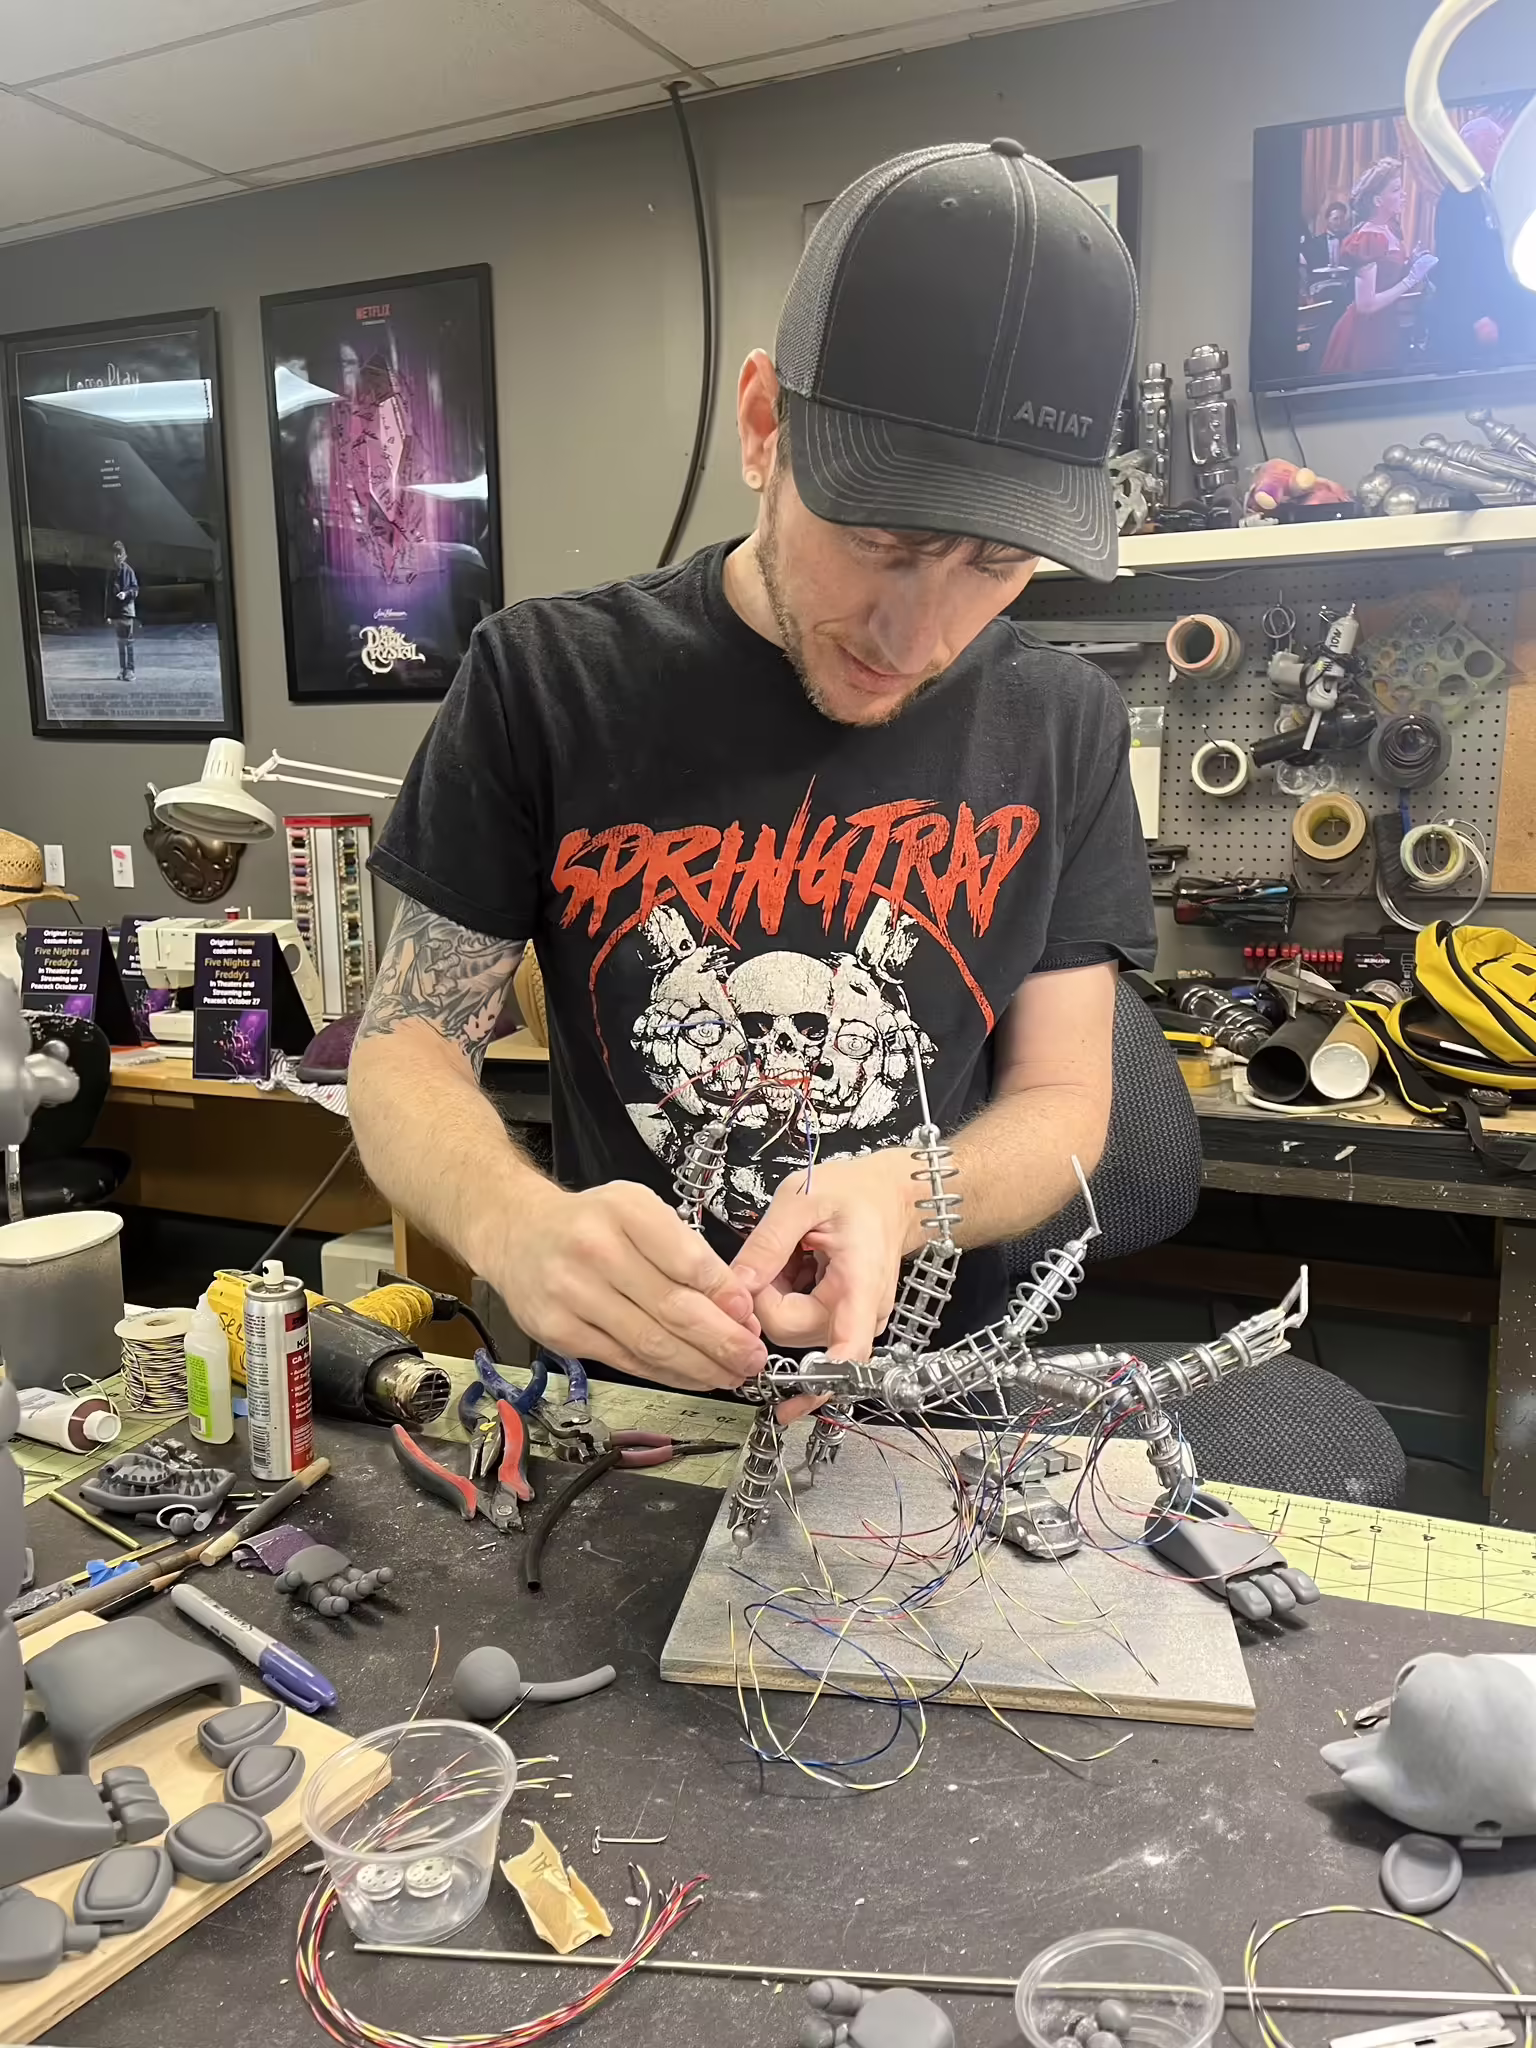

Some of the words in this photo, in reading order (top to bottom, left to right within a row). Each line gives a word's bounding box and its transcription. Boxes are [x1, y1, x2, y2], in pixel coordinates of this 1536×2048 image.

[356, 303, 391, 320] NETFLIX
[1013, 400, 1093, 438] ARIAT
[359, 626, 415, 648] DARK
[361, 644, 427, 675] CRYSTAL
[43, 930, 68, 938] Original
[68, 937, 83, 945] from
[209, 939, 234, 947] Original
[34, 946, 51, 955] Five
[53, 947, 79, 957] Nights
[81, 948, 90, 956] at
[237, 947, 253, 955] from
[44, 958, 78, 968] Freddy's
[204, 957, 221, 967] Five
[223, 958, 250, 969] Nights
[251, 959, 261, 967] at
[40, 975, 70, 984] Streaming
[215, 970, 249, 980] Freddy's
[30, 982, 54, 990] Peacock
[54, 983, 78, 991] October
[78, 983, 88, 991] 27
[242, 980, 255, 988] and
[212, 988, 242, 998] Streaming
[203, 996, 227, 1004] Peacock
[227, 997, 252, 1005] October
